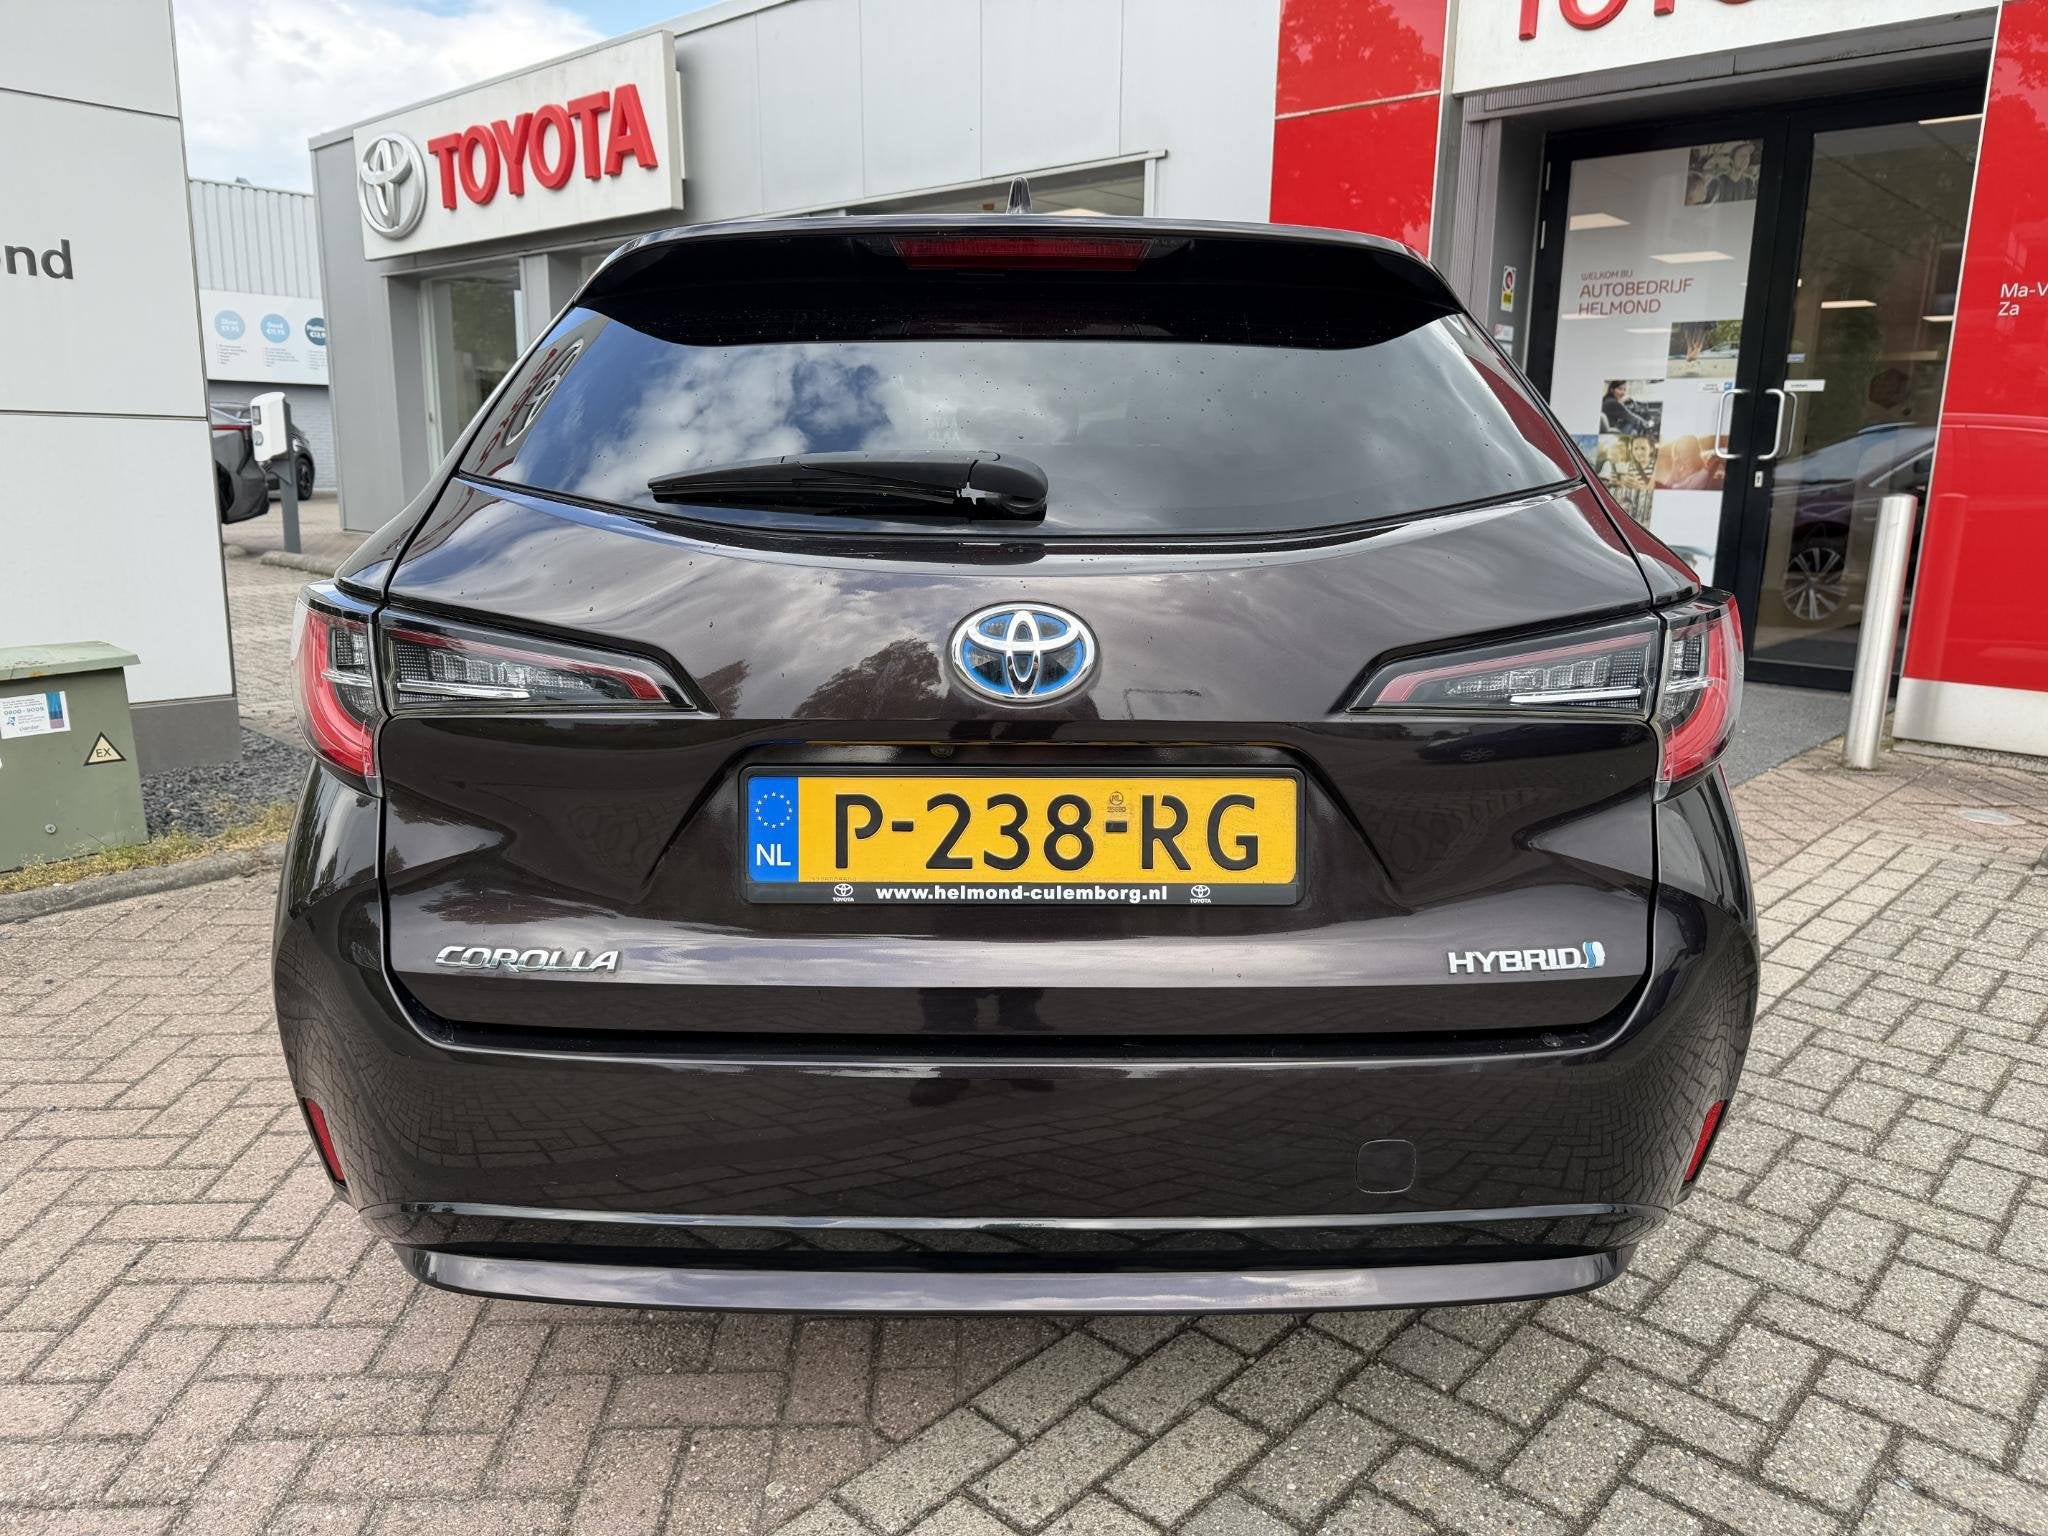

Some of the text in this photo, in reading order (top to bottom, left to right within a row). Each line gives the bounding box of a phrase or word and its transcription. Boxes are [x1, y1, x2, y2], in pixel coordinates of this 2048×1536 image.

[427, 84, 658, 210] TOYOTA
[0, 239, 73, 280] nd
[1580, 269, 1633, 280] WELKOM BIJ
[1579, 277, 1694, 298] AUTOBEDRIJF
[1578, 299, 1661, 316] HELMOND
[1998, 301, 2020, 316] Za
[96, 747, 111, 758] EX
[836, 793, 1259, 871] P-238-RG
[756, 843, 791, 866] NL
[875, 885, 1168, 904] www.helmond-culemborg.nl
[434, 945, 621, 973] COROLLA
[1448, 947, 1583, 974] HYBRID
